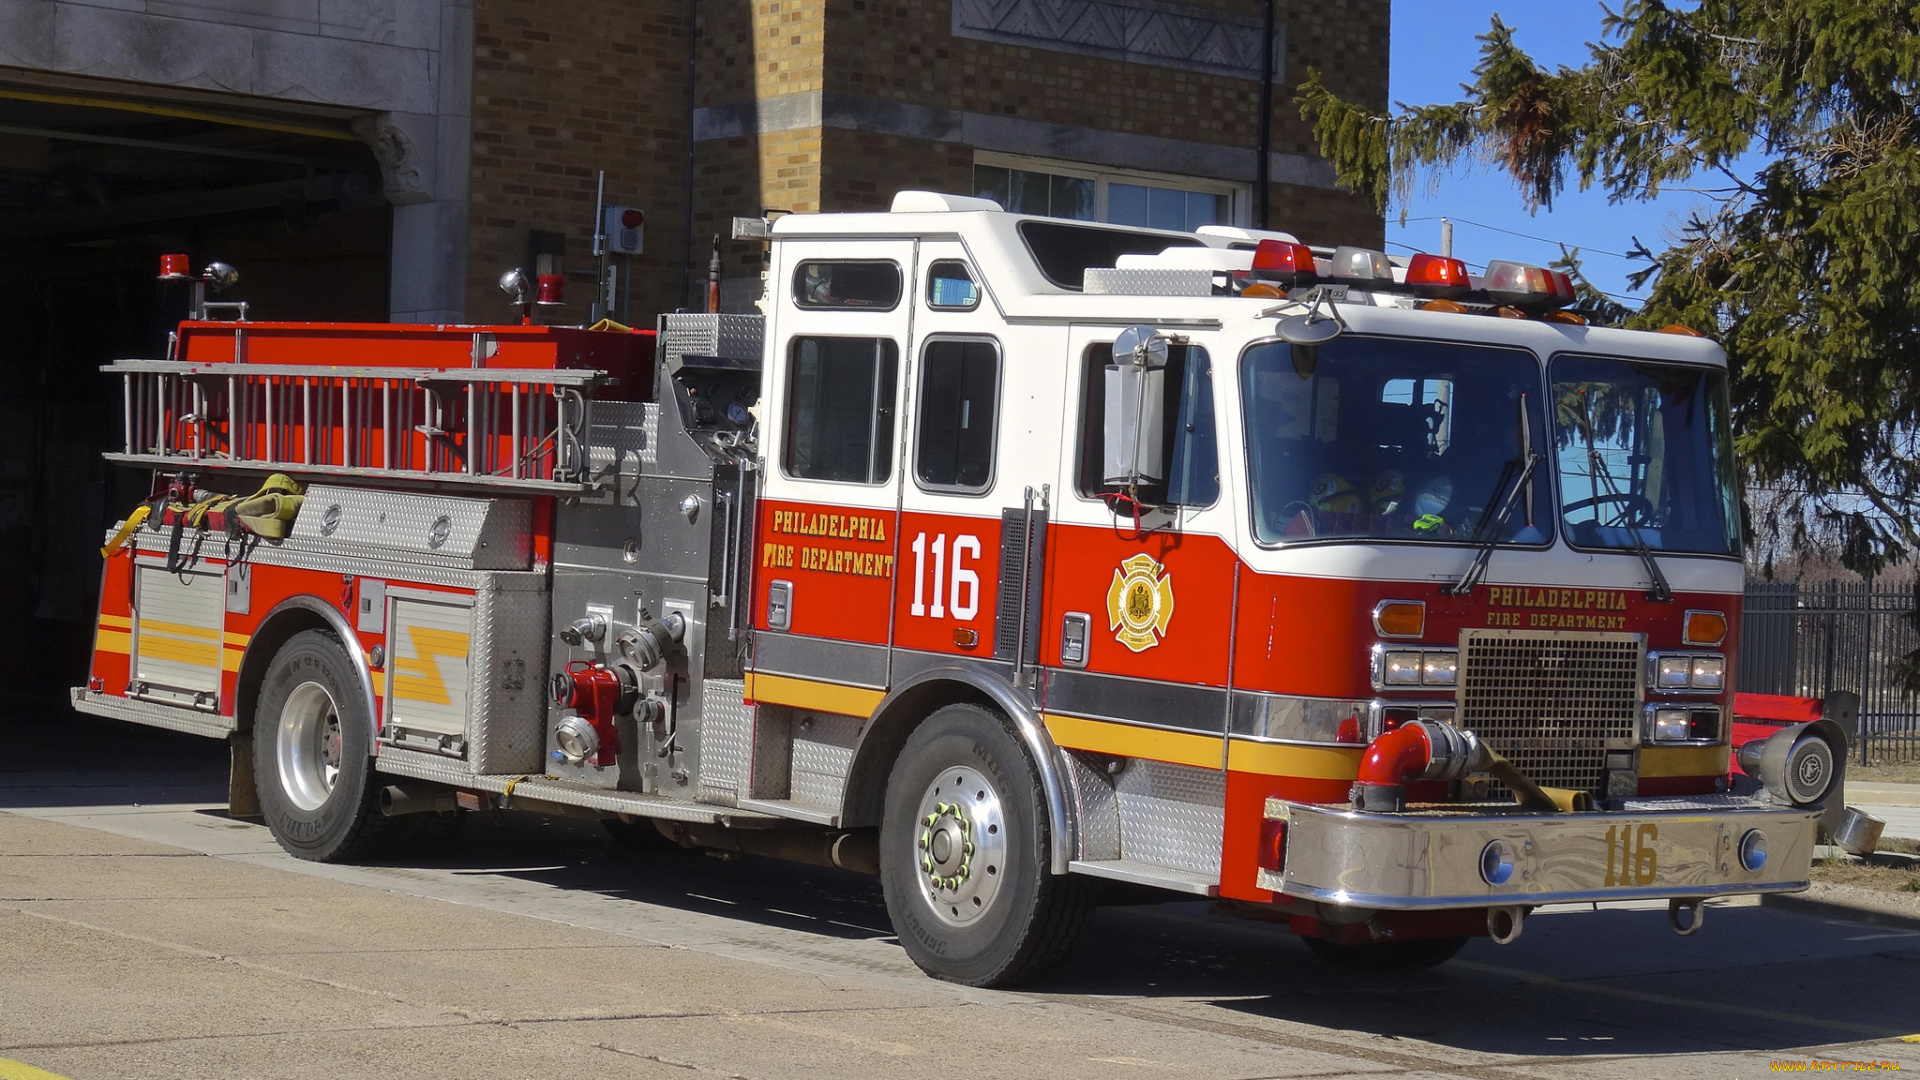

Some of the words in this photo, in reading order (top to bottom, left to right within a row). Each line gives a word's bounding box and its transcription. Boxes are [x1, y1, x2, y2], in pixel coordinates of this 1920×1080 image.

[773, 510, 886, 541] PHILADELPHIA
[762, 543, 794, 568] FIRE
[801, 547, 893, 578] DEPARTMENT
[910, 532, 981, 621] 116
[1488, 587, 1627, 610] PHILADELPHIA
[1486, 612, 1521, 627] FIRE
[1529, 614, 1626, 629] DEPARTMENT
[1604, 823, 1658, 887] 116
